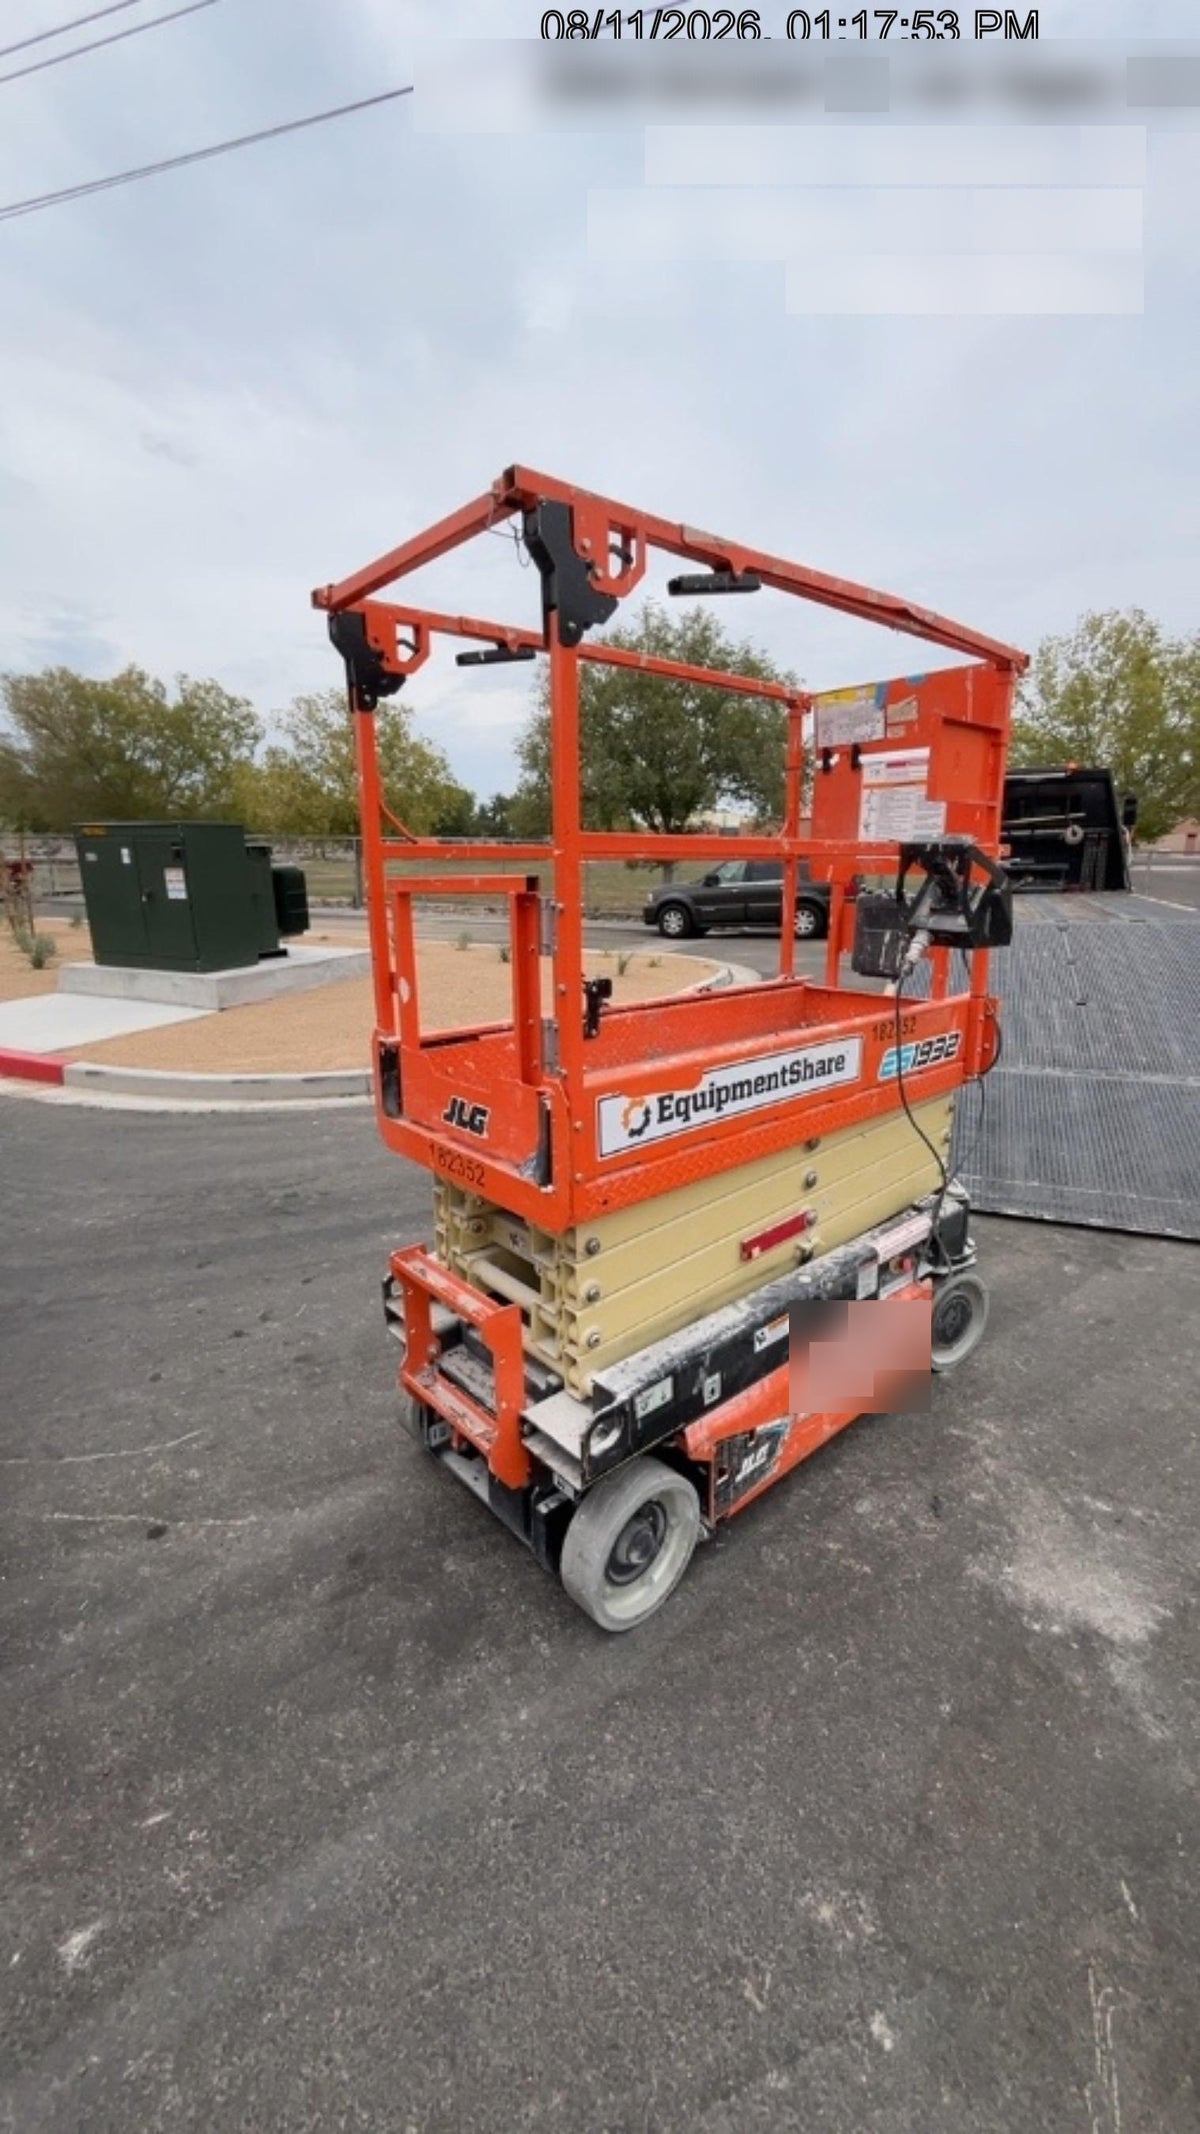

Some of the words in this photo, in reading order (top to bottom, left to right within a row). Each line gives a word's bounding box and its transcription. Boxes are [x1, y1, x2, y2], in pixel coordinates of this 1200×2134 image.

[873, 1016, 917, 1041] 18252
[656, 1054, 846, 1124] EquipmentShare
[442, 1096, 489, 1138] JLG
[428, 1142, 486, 1188] 182352
